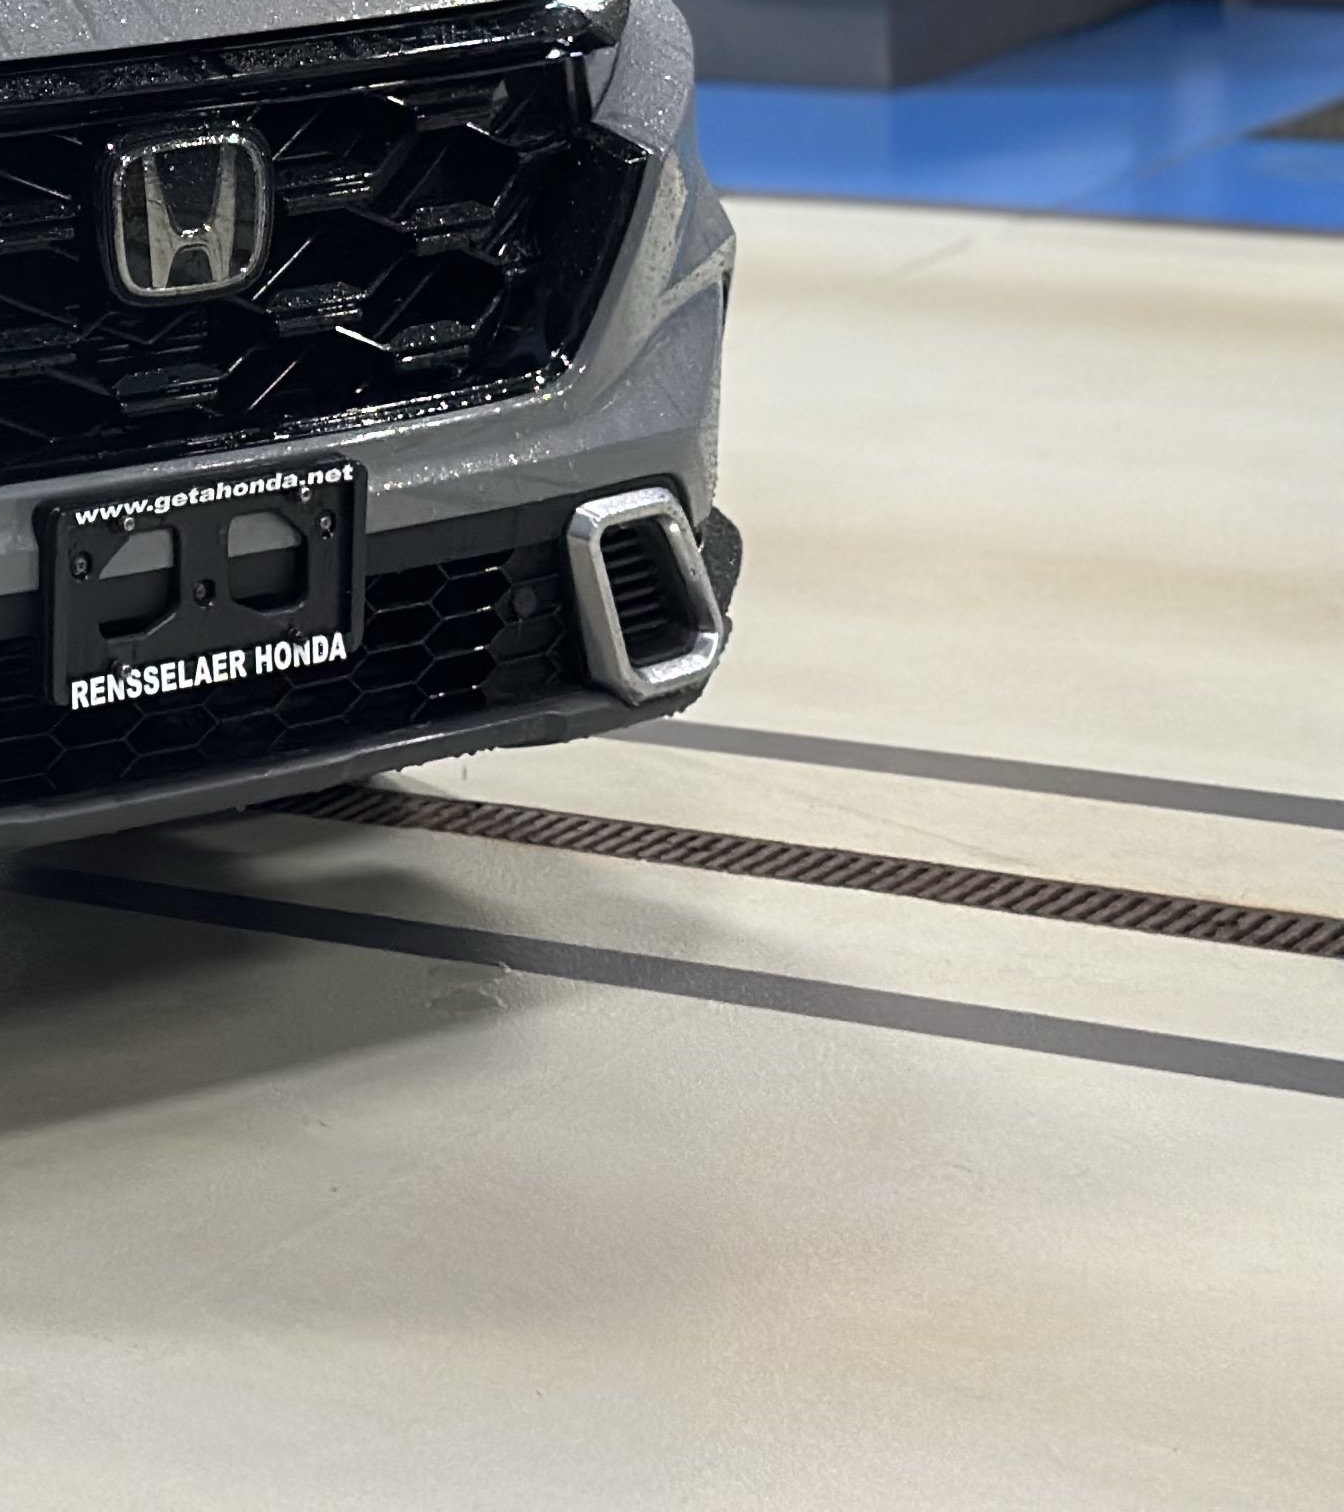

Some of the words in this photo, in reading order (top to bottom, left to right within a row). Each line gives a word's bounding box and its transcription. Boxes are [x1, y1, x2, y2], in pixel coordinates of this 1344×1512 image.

[74, 462, 355, 526] www.getahonda.net
[70, 649, 248, 711] RENSSELAER
[254, 631, 349, 676] HONDA
